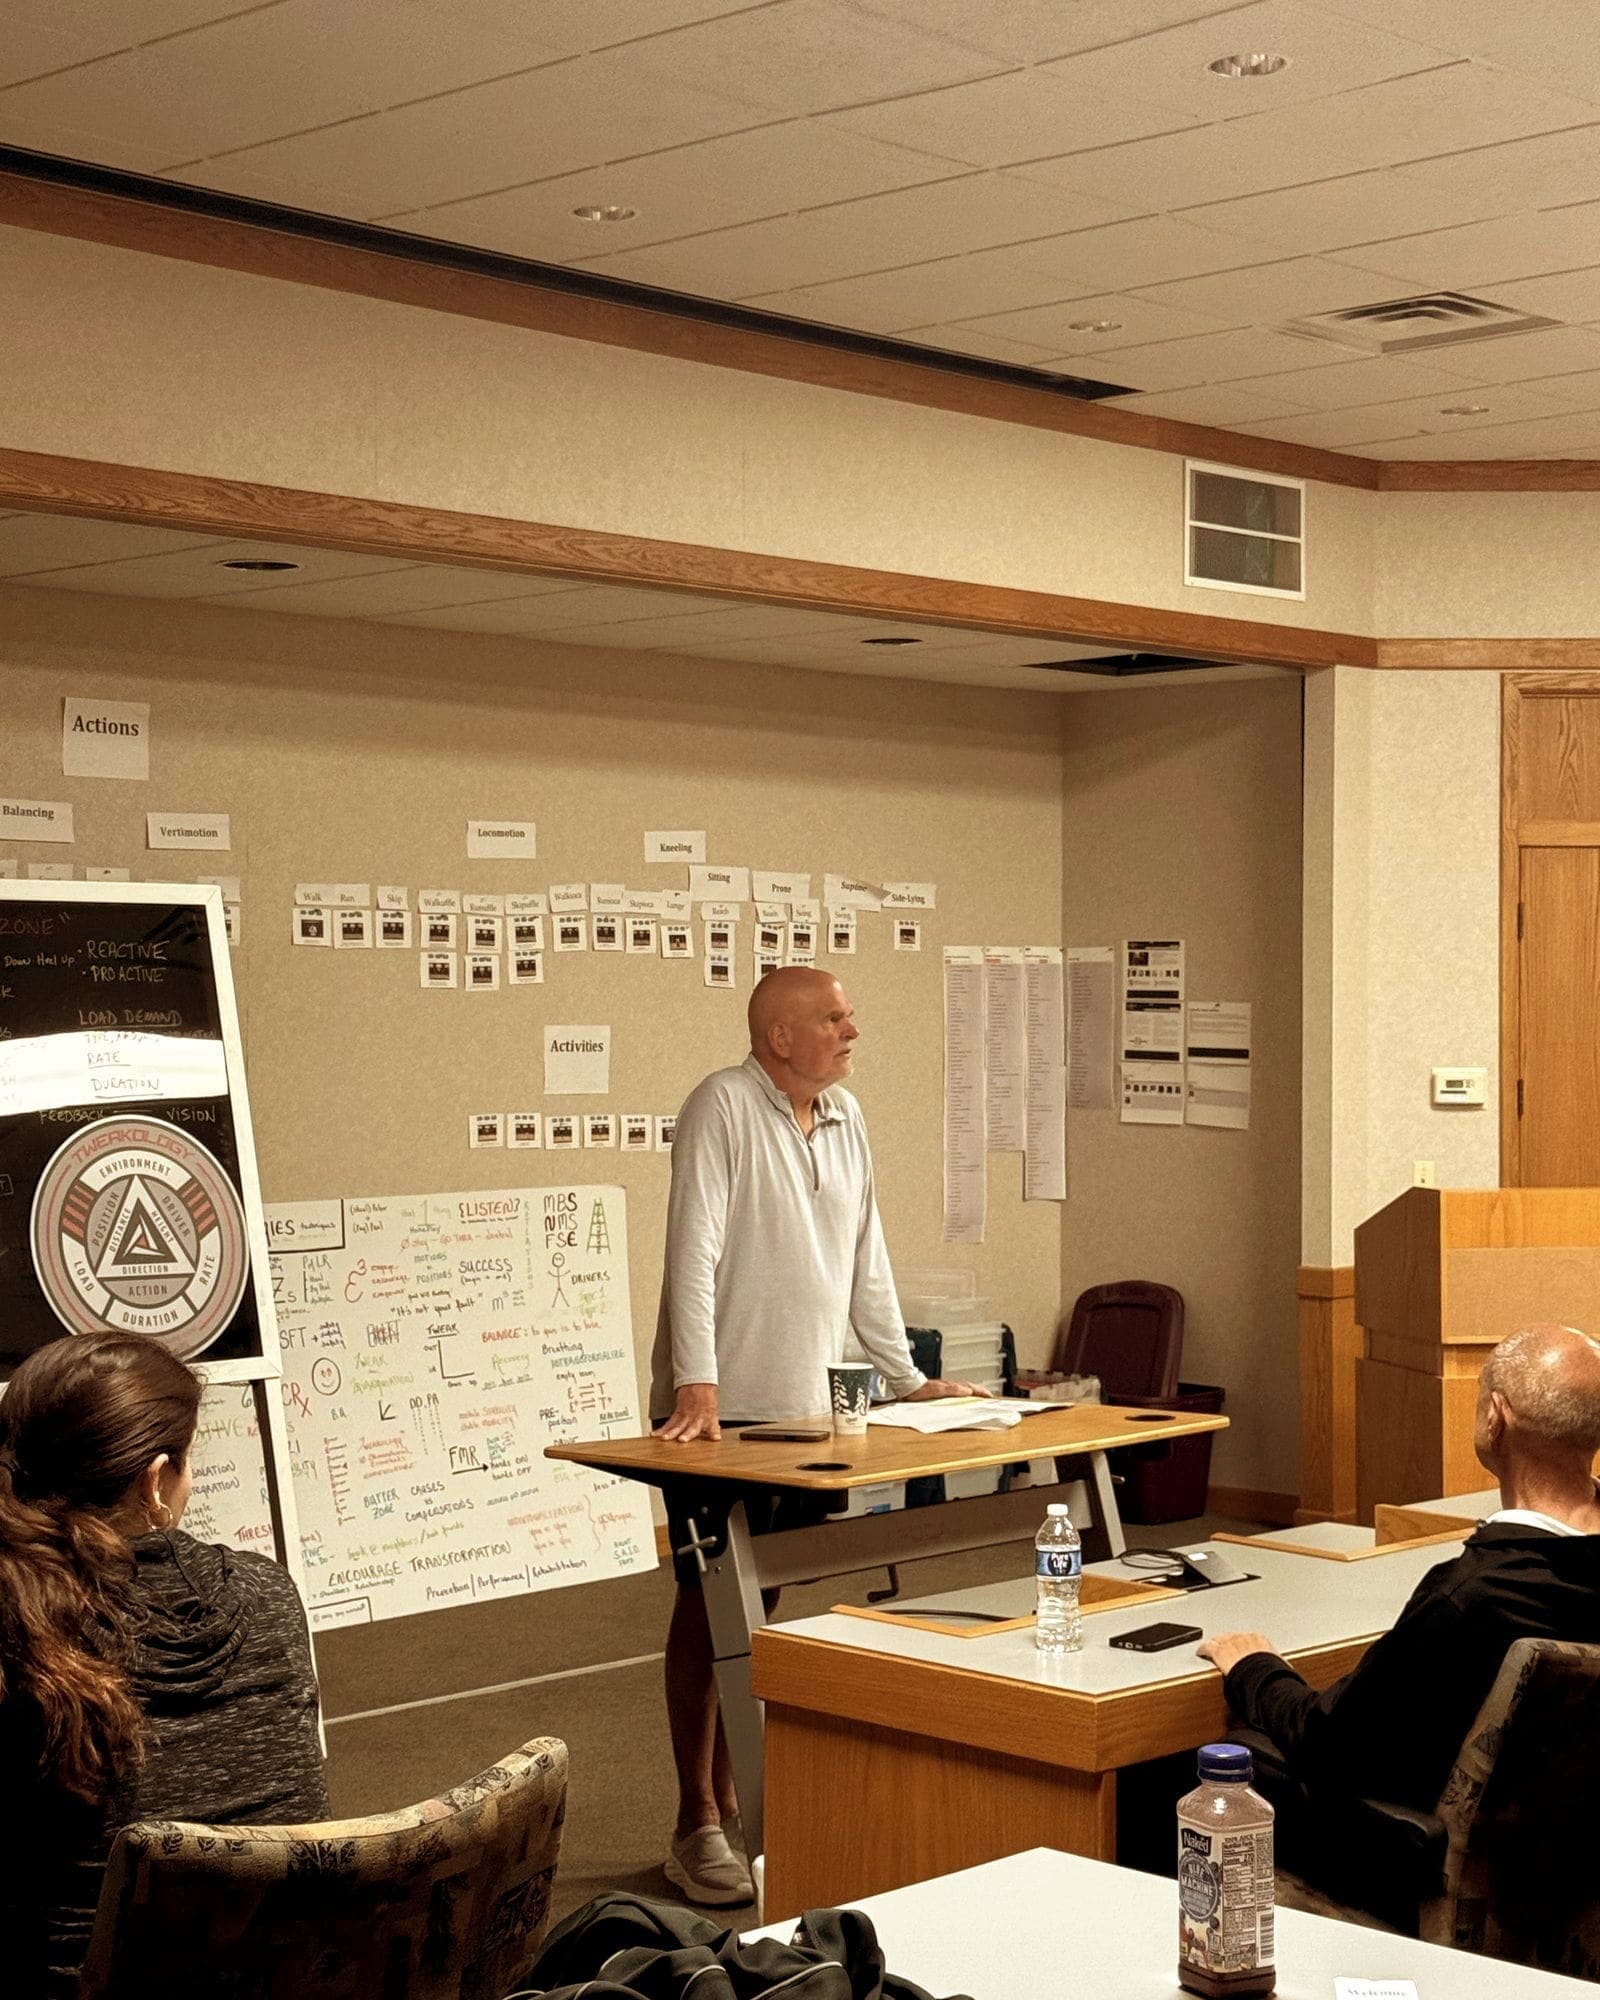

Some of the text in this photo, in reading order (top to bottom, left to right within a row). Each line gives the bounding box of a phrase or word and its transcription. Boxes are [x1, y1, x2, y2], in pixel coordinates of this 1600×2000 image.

[72, 714, 140, 737] Actions
[3, 805, 55, 820] Balancing
[159, 826, 218, 838] Vertimotion
[477, 828, 526, 839] Locomotion
[660, 843, 692, 854] Kneeling
[707, 872, 731, 883] Sitting
[841, 881, 868, 893] Supine
[303, 892, 323, 902] Walk
[771, 883, 792, 894] Prone
[891, 893, 926, 905] Side-Lying
[86, 939, 171, 961] REACTIVE
[78, 1010, 183, 1027] LOAD DEMAND
[550, 1037, 604, 1054] Activities
[39, 1105, 216, 1125] FEEDBACK VISION
[99, 1157, 172, 1179] ENVIRONMENT
[543, 1192, 578, 1213] MBS
[92, 1191, 120, 1247] POSITION
[162, 1195, 191, 1239] DRIVER
[544, 1212, 578, 1232] NMS
[108, 1207, 132, 1253] DISTANCE
[151, 1210, 175, 1244] HEIGHT
[545, 1231, 578, 1249] FSE
[122, 1264, 169, 1275] DIRECTION
[200, 1254, 216, 1286] RATE
[458, 1257, 513, 1274] SUCCESS
[74, 1260, 95, 1293] LOAD
[128, 1285, 168, 1296] ACTION
[122, 1310, 179, 1327] DURATION
[449, 1445, 481, 1469] FMR
[328, 1560, 402, 1587] ENCOURAGE
[409, 1540, 512, 1573] TRANSFORMATION
[1183, 1831, 1209, 1853] Naked
[1180, 1875, 1214, 1897] MACHINE
